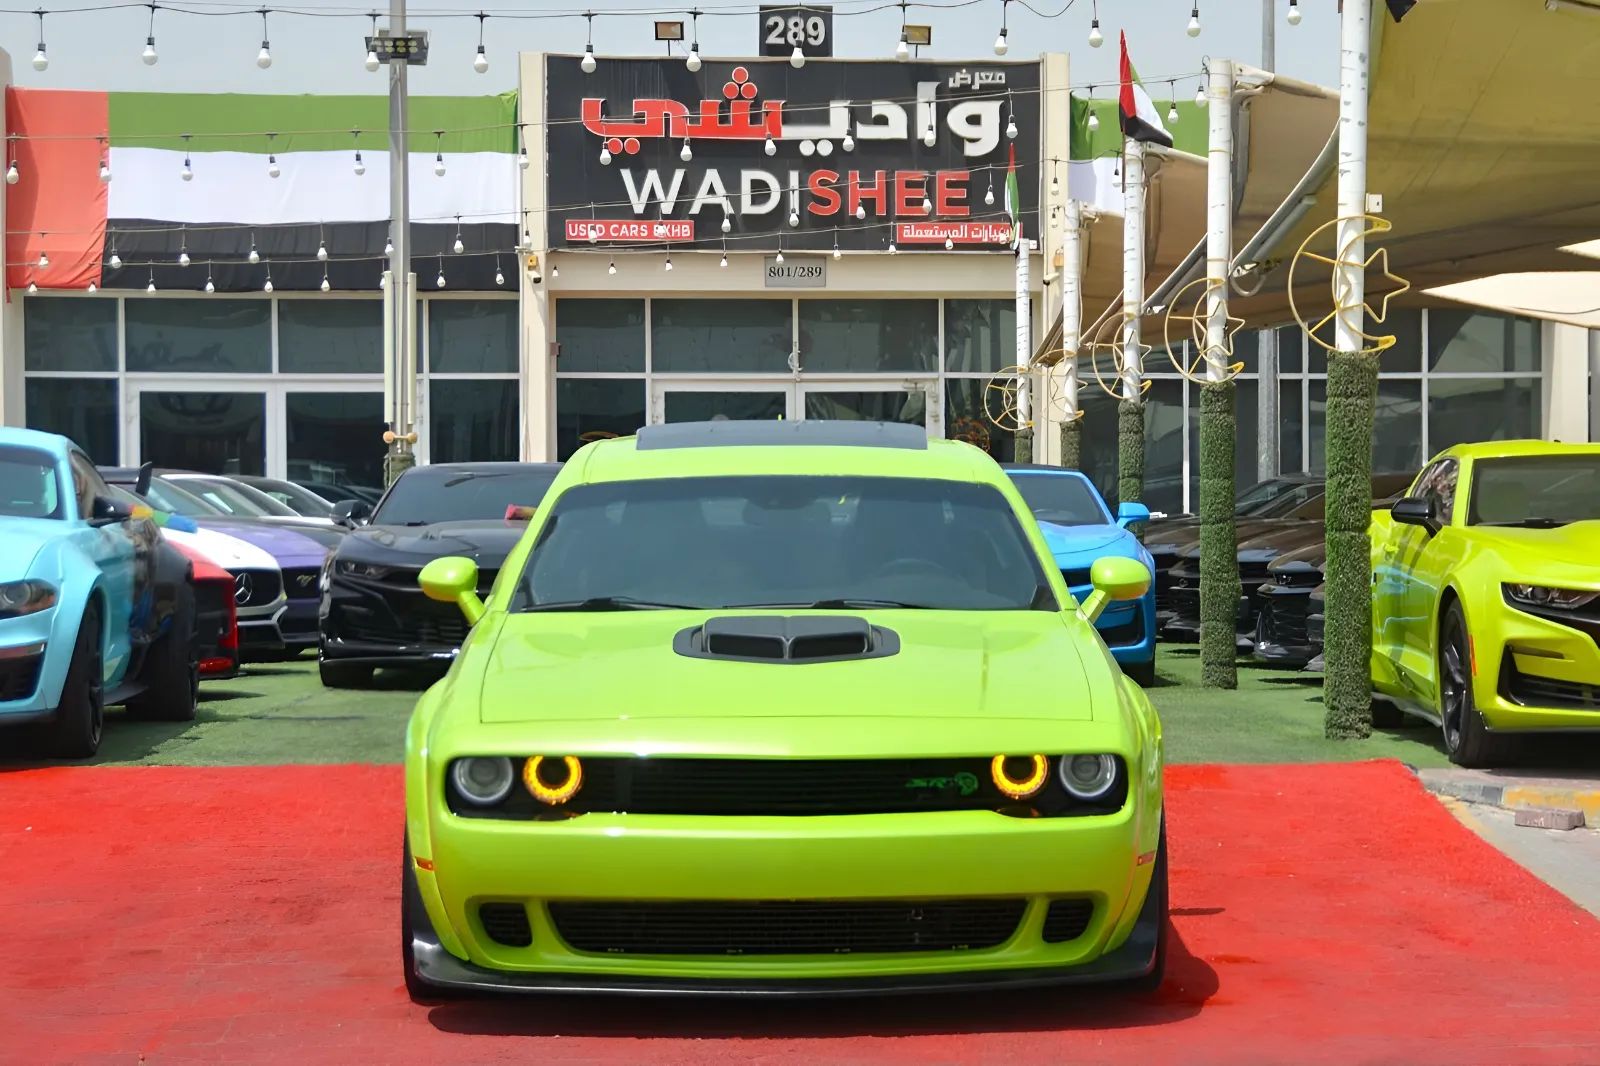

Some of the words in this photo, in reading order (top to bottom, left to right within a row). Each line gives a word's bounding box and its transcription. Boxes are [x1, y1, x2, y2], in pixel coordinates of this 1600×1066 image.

[765, 15, 826, 46] 289
[948, 68, 1006, 90] معرض
[568, 223, 606, 238] USED
[609, 224, 648, 237] CARS
[903, 224, 968, 239] المستعملة
[768, 266, 822, 278] 801/289
